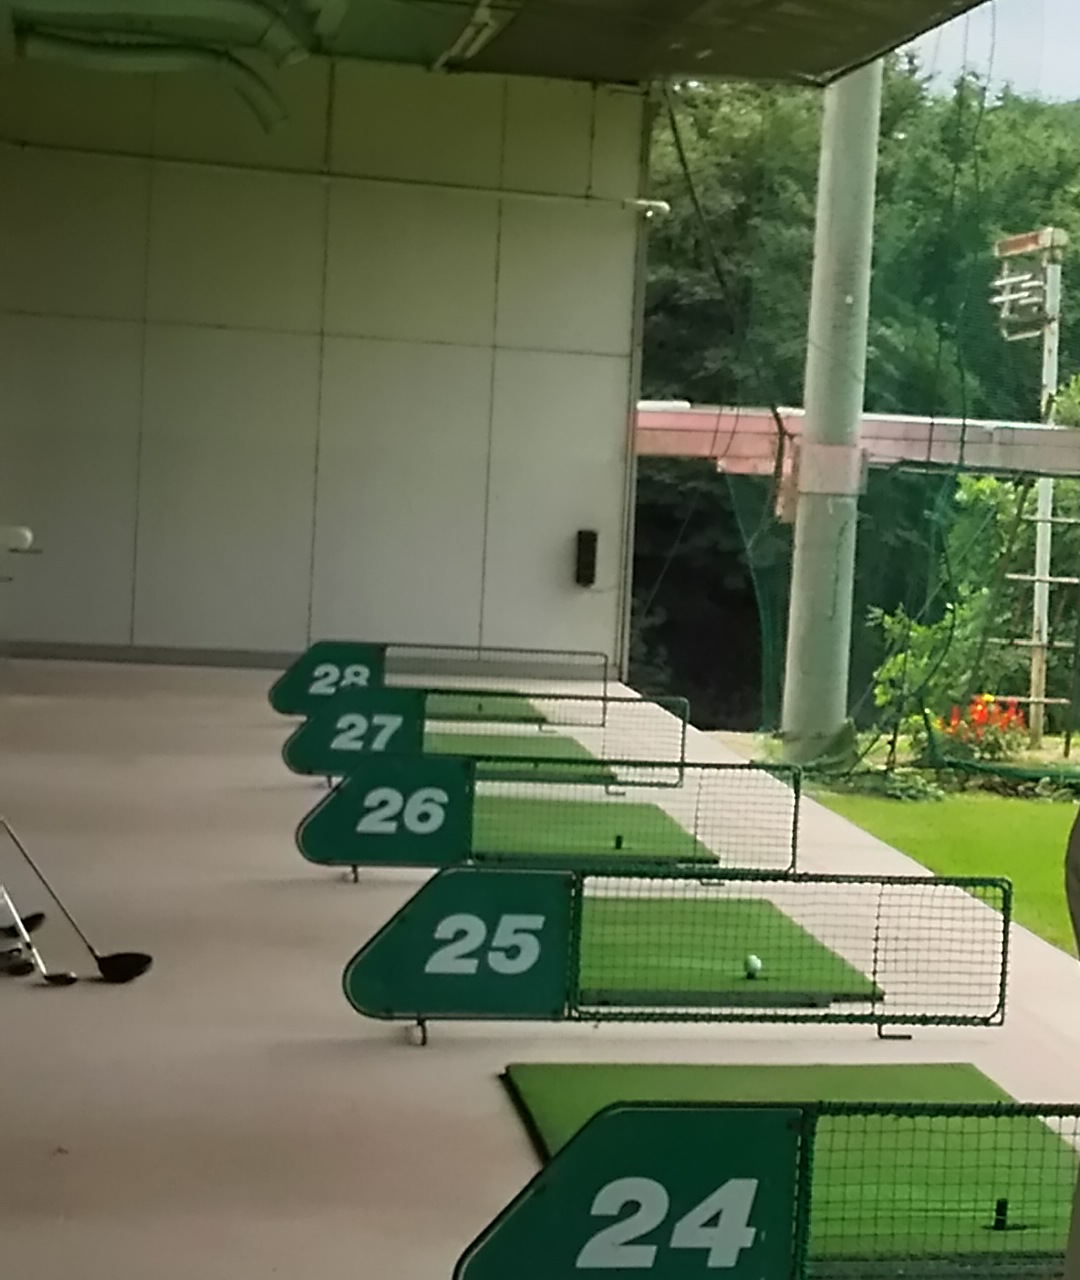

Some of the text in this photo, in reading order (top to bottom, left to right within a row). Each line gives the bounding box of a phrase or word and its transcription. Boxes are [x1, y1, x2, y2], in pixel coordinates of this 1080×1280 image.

[309, 664, 370, 696] 28
[330, 714, 403, 751] 27
[356, 787, 449, 834] 26
[424, 914, 546, 974] 25
[575, 1177, 759, 1268] 24
